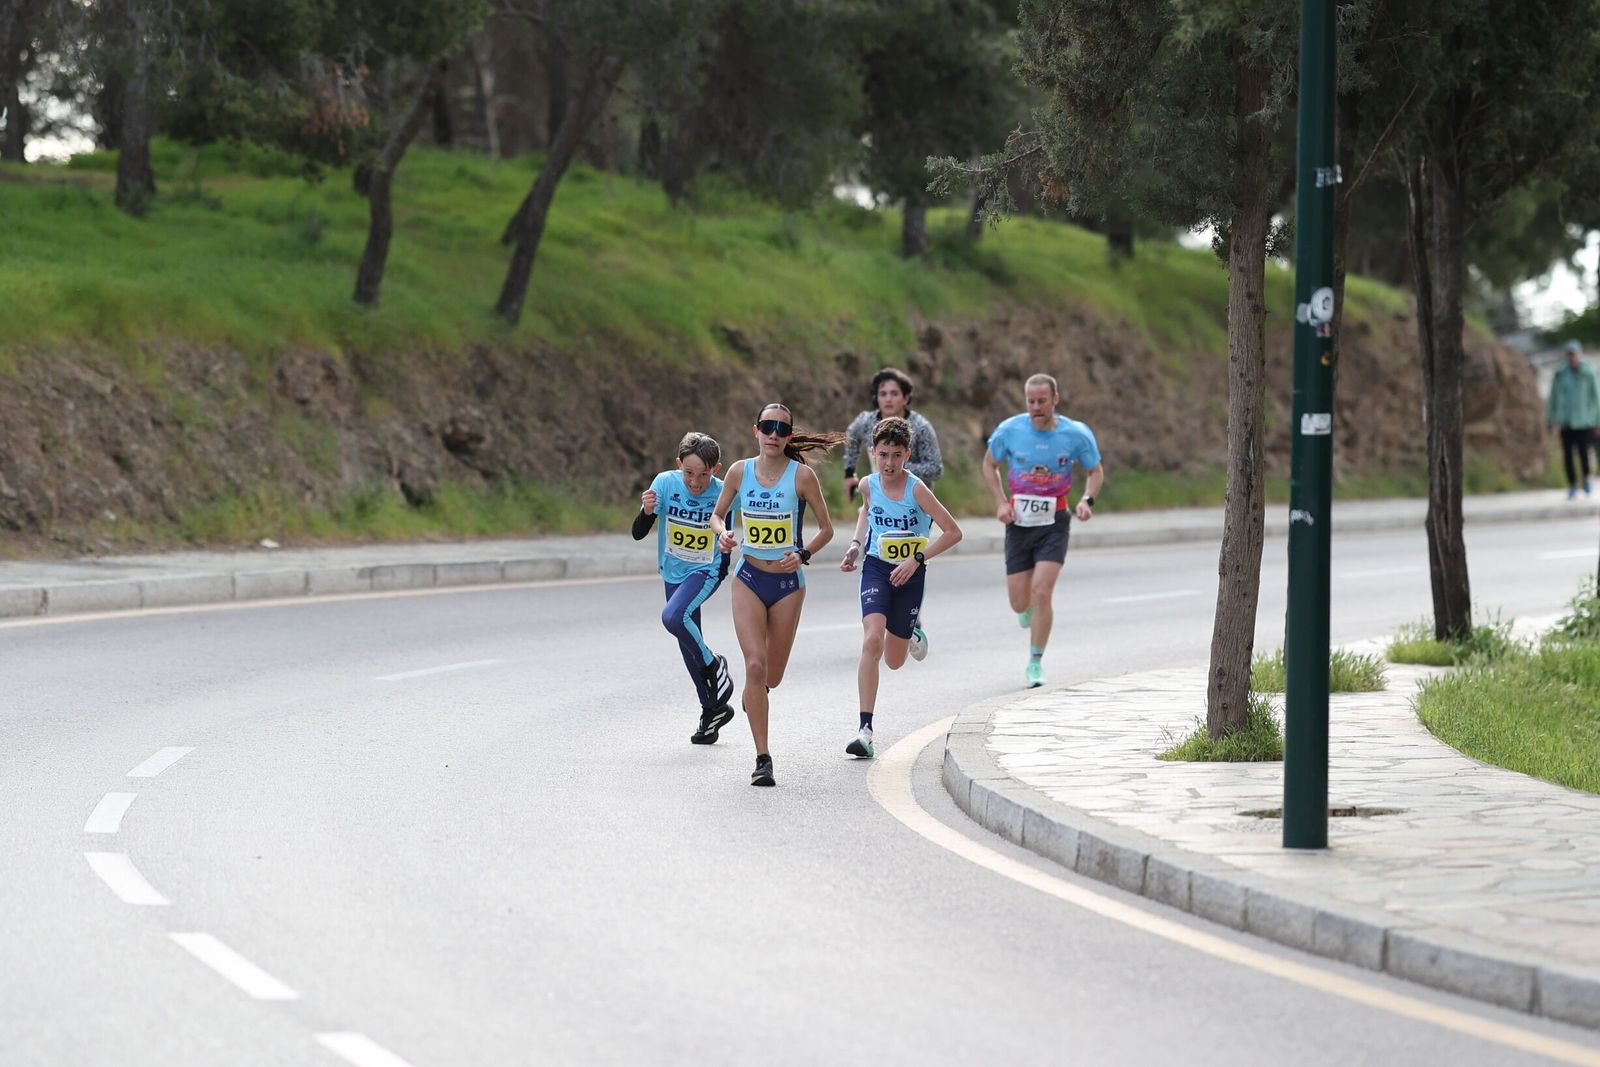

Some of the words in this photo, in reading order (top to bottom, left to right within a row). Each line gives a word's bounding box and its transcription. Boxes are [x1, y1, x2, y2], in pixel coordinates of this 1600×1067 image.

[668, 505, 712, 523] nerja
[749, 500, 780, 510] nerja
[1021, 499, 1050, 513] 764
[874, 515, 919, 531] nerja
[673, 531, 708, 551] 929
[749, 526, 787, 544] 920
[887, 541, 922, 559] 907
